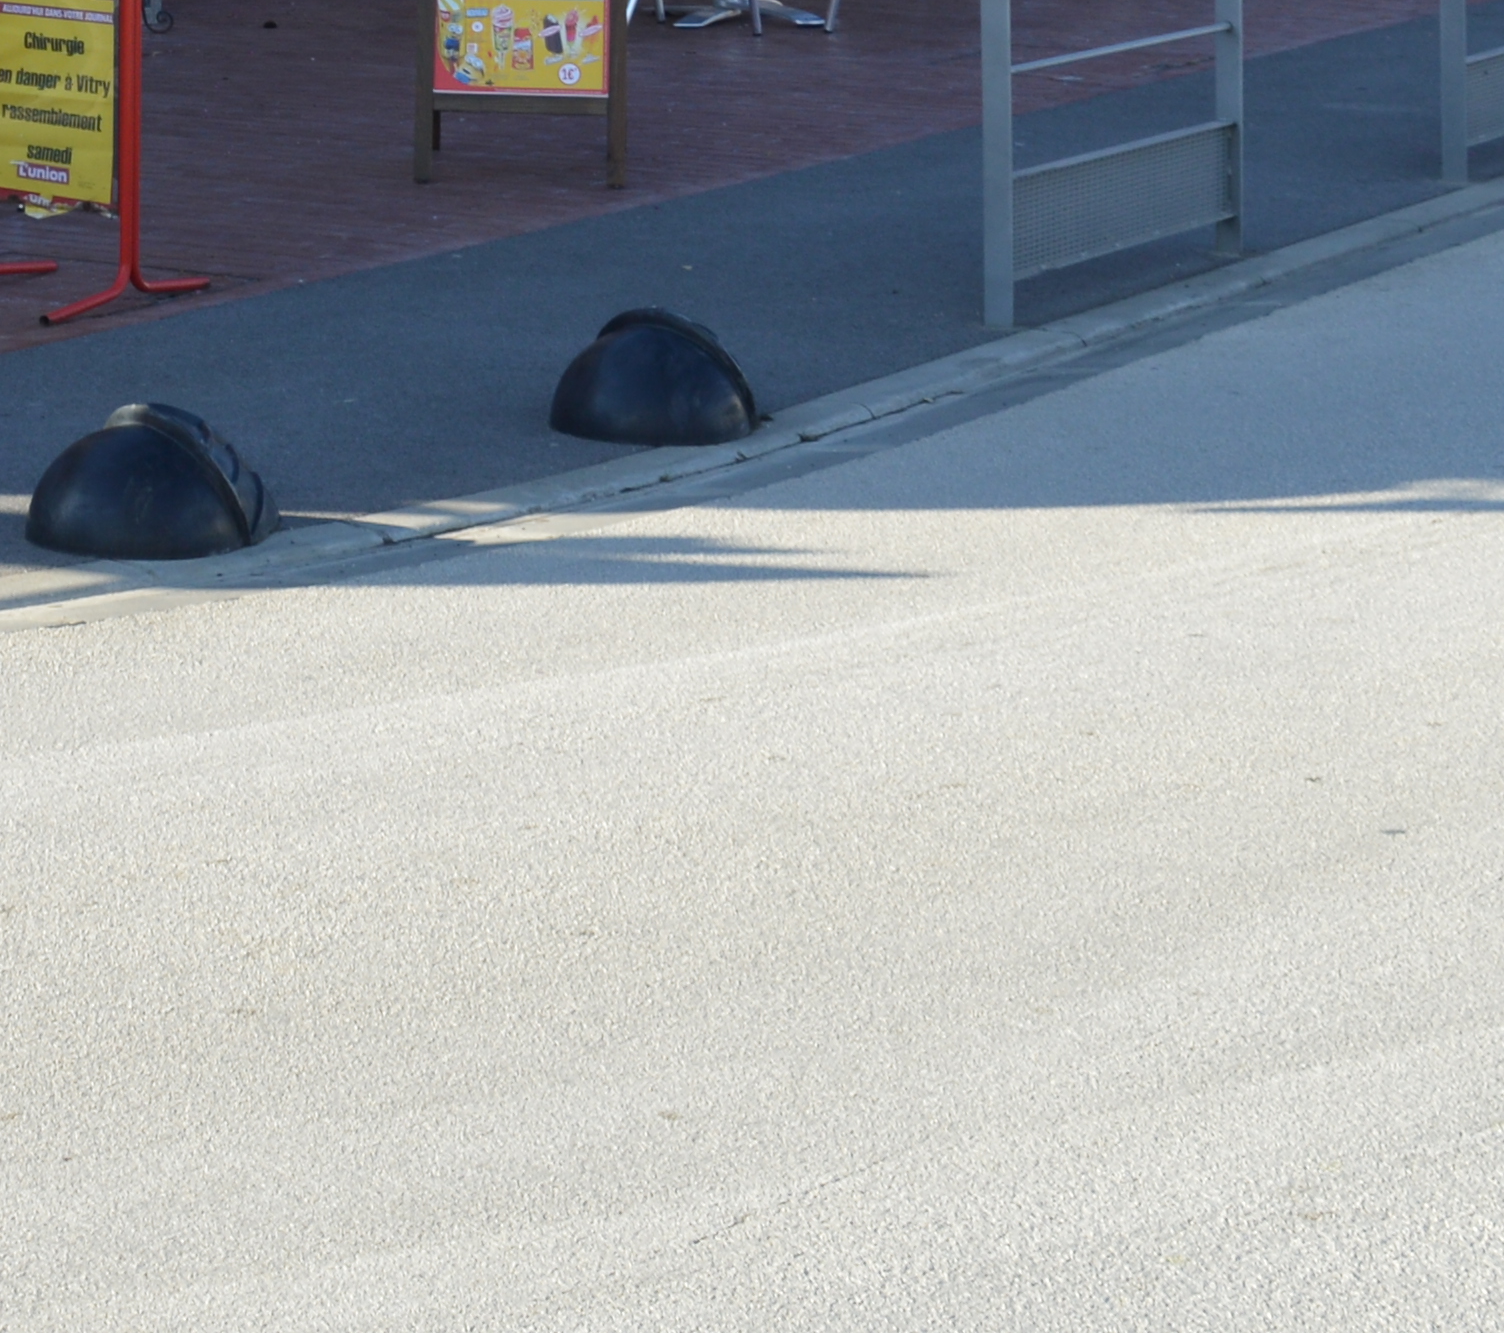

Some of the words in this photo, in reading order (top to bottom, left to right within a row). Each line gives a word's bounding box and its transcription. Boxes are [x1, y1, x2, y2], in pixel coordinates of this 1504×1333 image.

[45, 7, 63, 18] DANS
[64, 10, 83, 21] VOTRE
[84, 12, 113, 24] JOURNAL
[24, 31, 85, 56] Chirurgie
[15, 67, 61, 92] danger
[65, 73, 74, 90] à
[76, 74, 111, 99] Vitry
[1, 103, 102, 133] rassemblement
[26, 144, 73, 166] samedi
[18, 164, 68, 183] L'union
